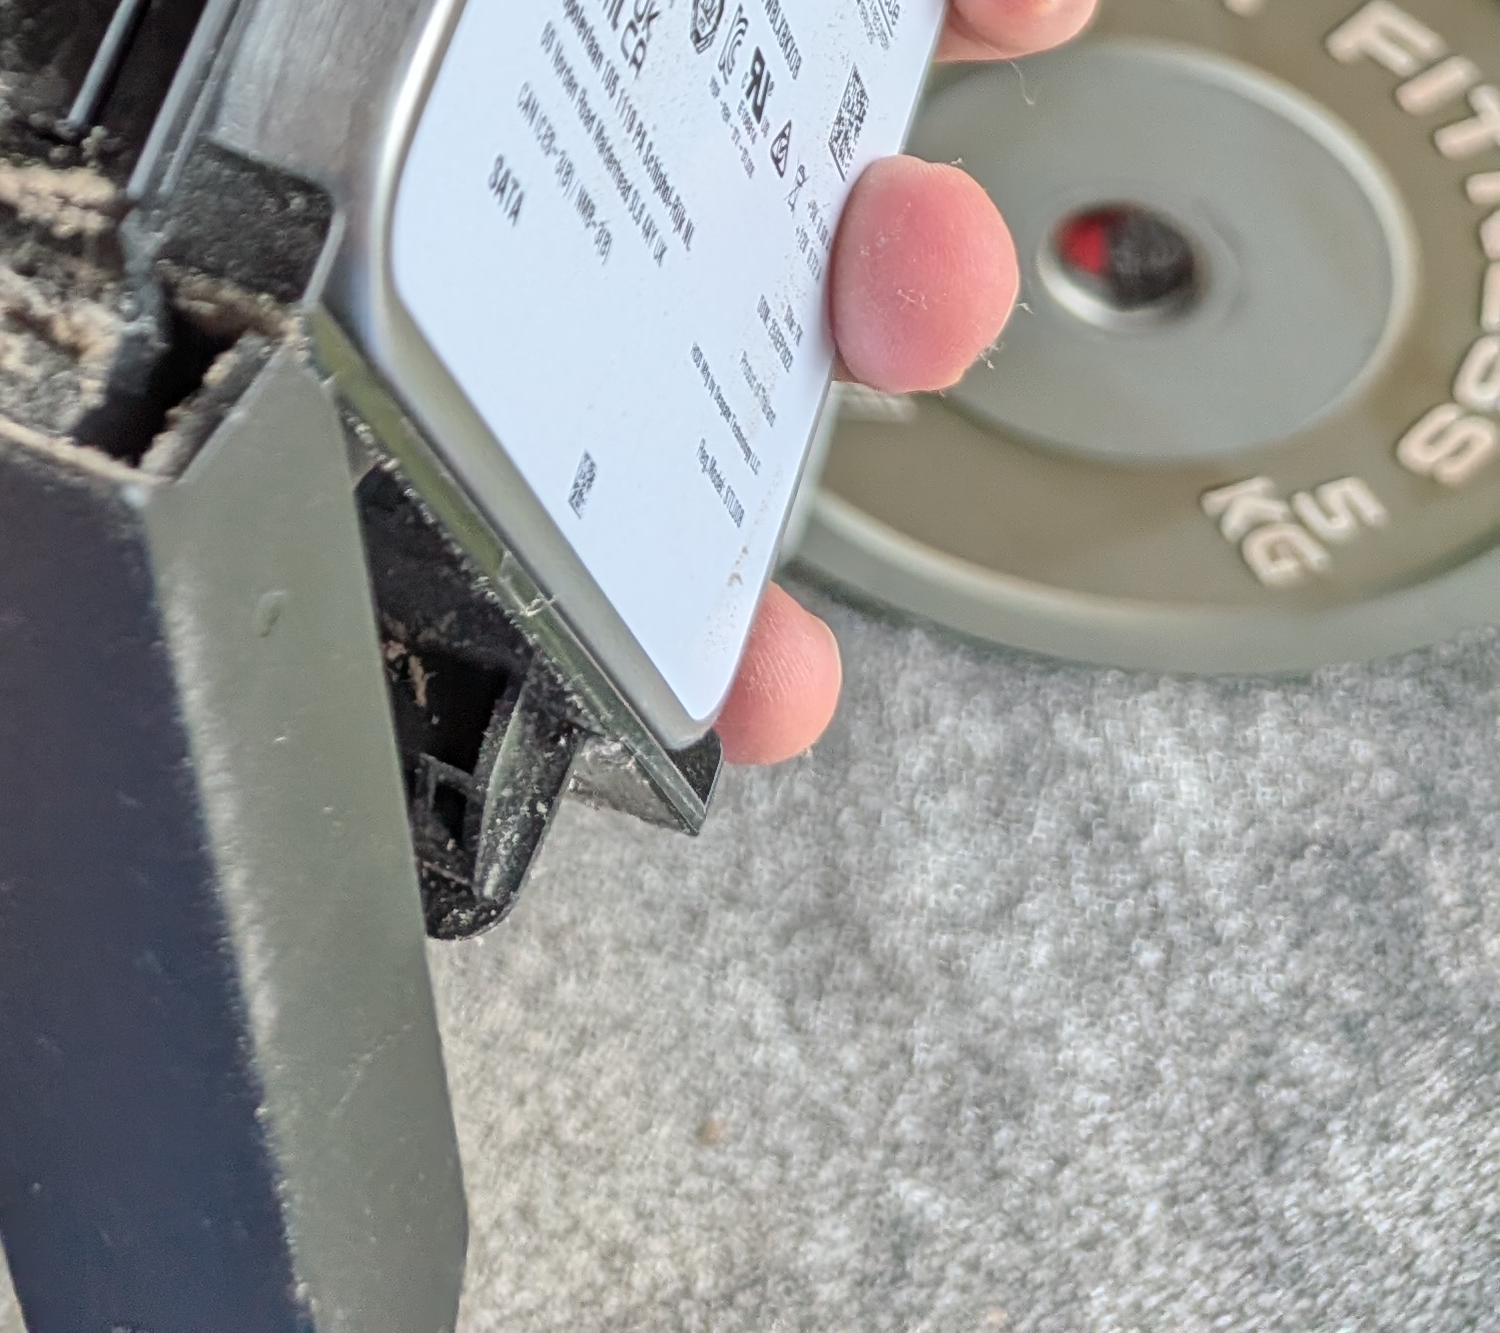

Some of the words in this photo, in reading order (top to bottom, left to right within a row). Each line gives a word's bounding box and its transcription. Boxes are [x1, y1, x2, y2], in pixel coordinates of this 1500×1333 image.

[517, 82, 540, 126] CAN
[576, 87, 598, 134] Road
[593, 119, 634, 204] Maidenhead
[489, 154, 525, 226] SATA
[601, 59, 621, 100] 105
[615, 87, 638, 134] 1119
[631, 121, 648, 156] PA
[681, 218, 695, 252] NL
